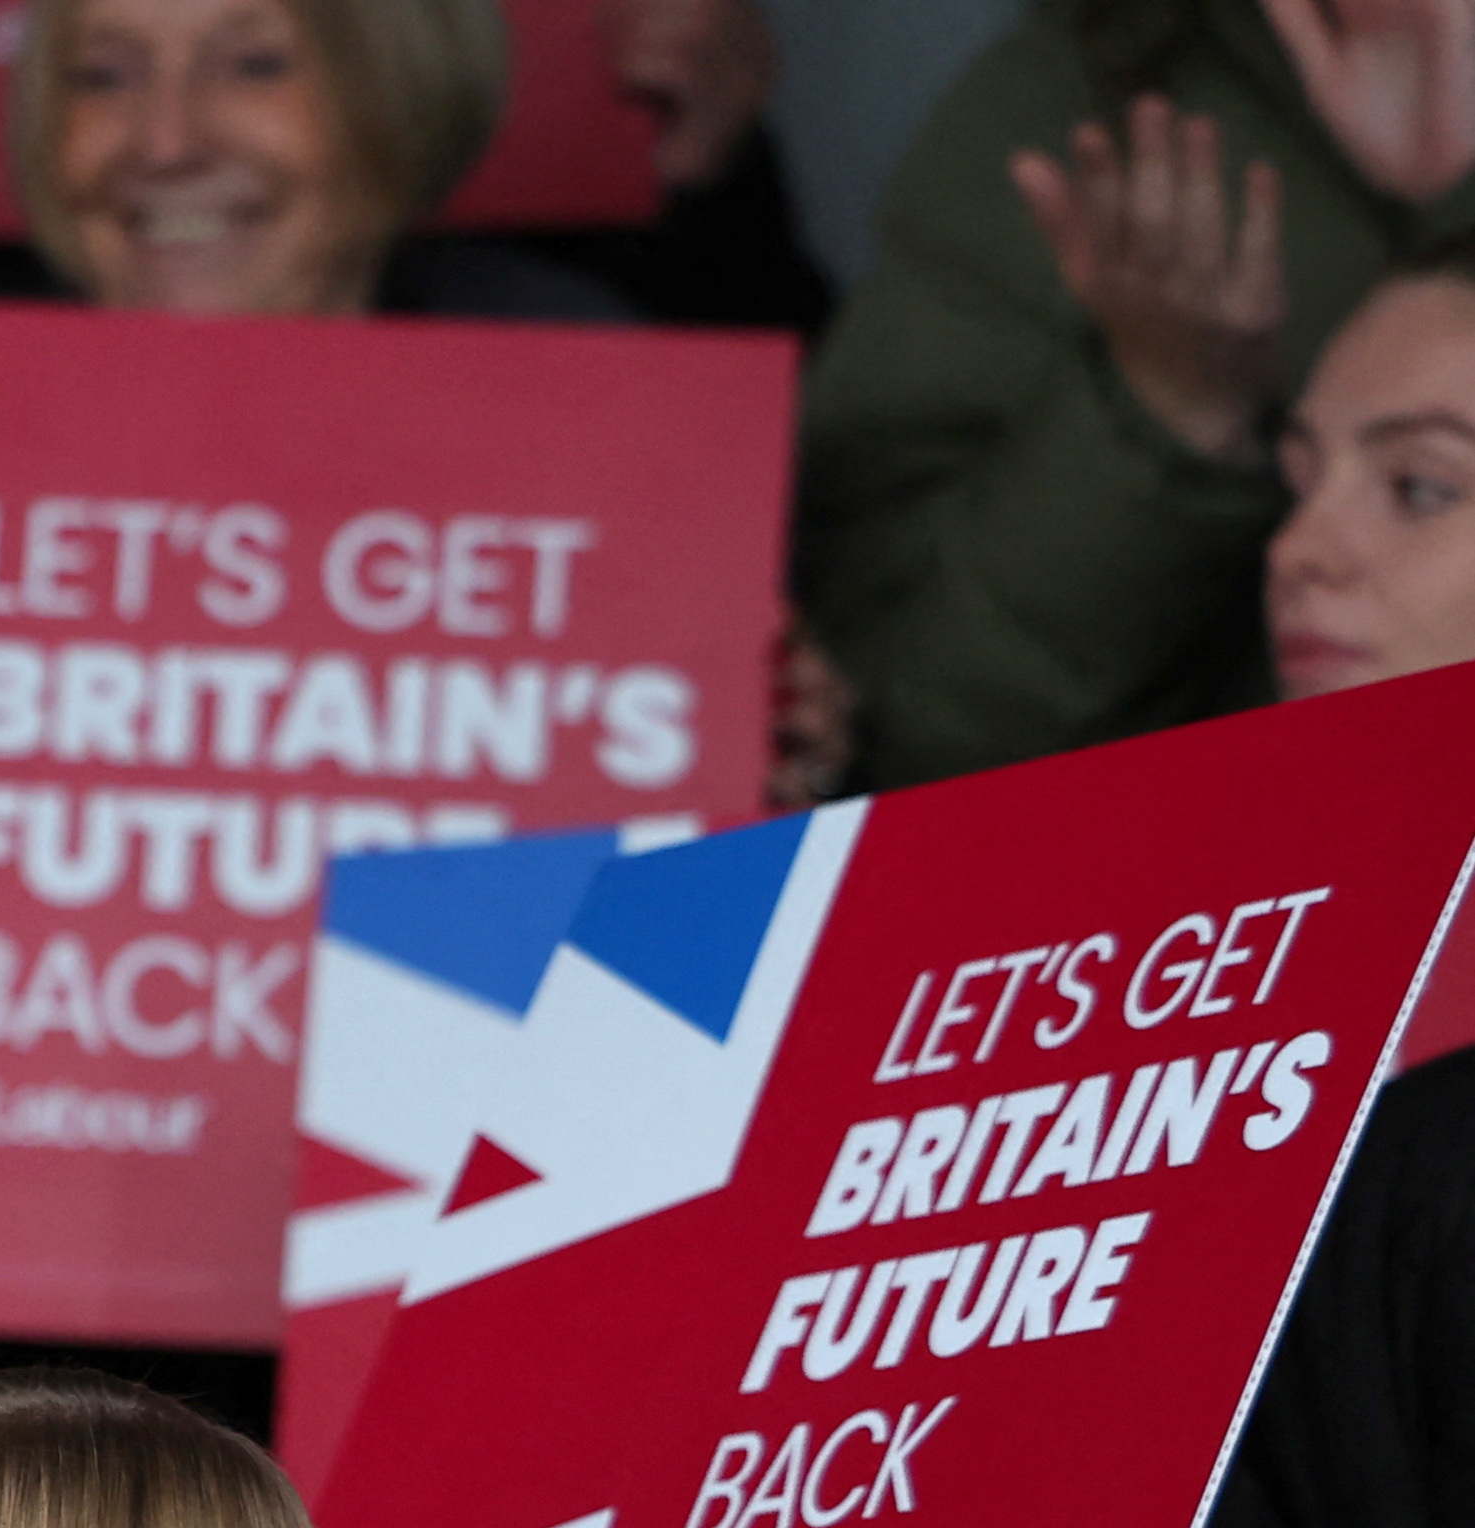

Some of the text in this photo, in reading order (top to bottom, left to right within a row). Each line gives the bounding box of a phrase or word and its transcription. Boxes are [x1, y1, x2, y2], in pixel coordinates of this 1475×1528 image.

[322, 508, 596, 640] GET
[871, 884, 1332, 1085] LET'S GET
[803, 1030, 1334, 1239] BRITAIN'S
[737, 1210, 1156, 1396] FUTURE
